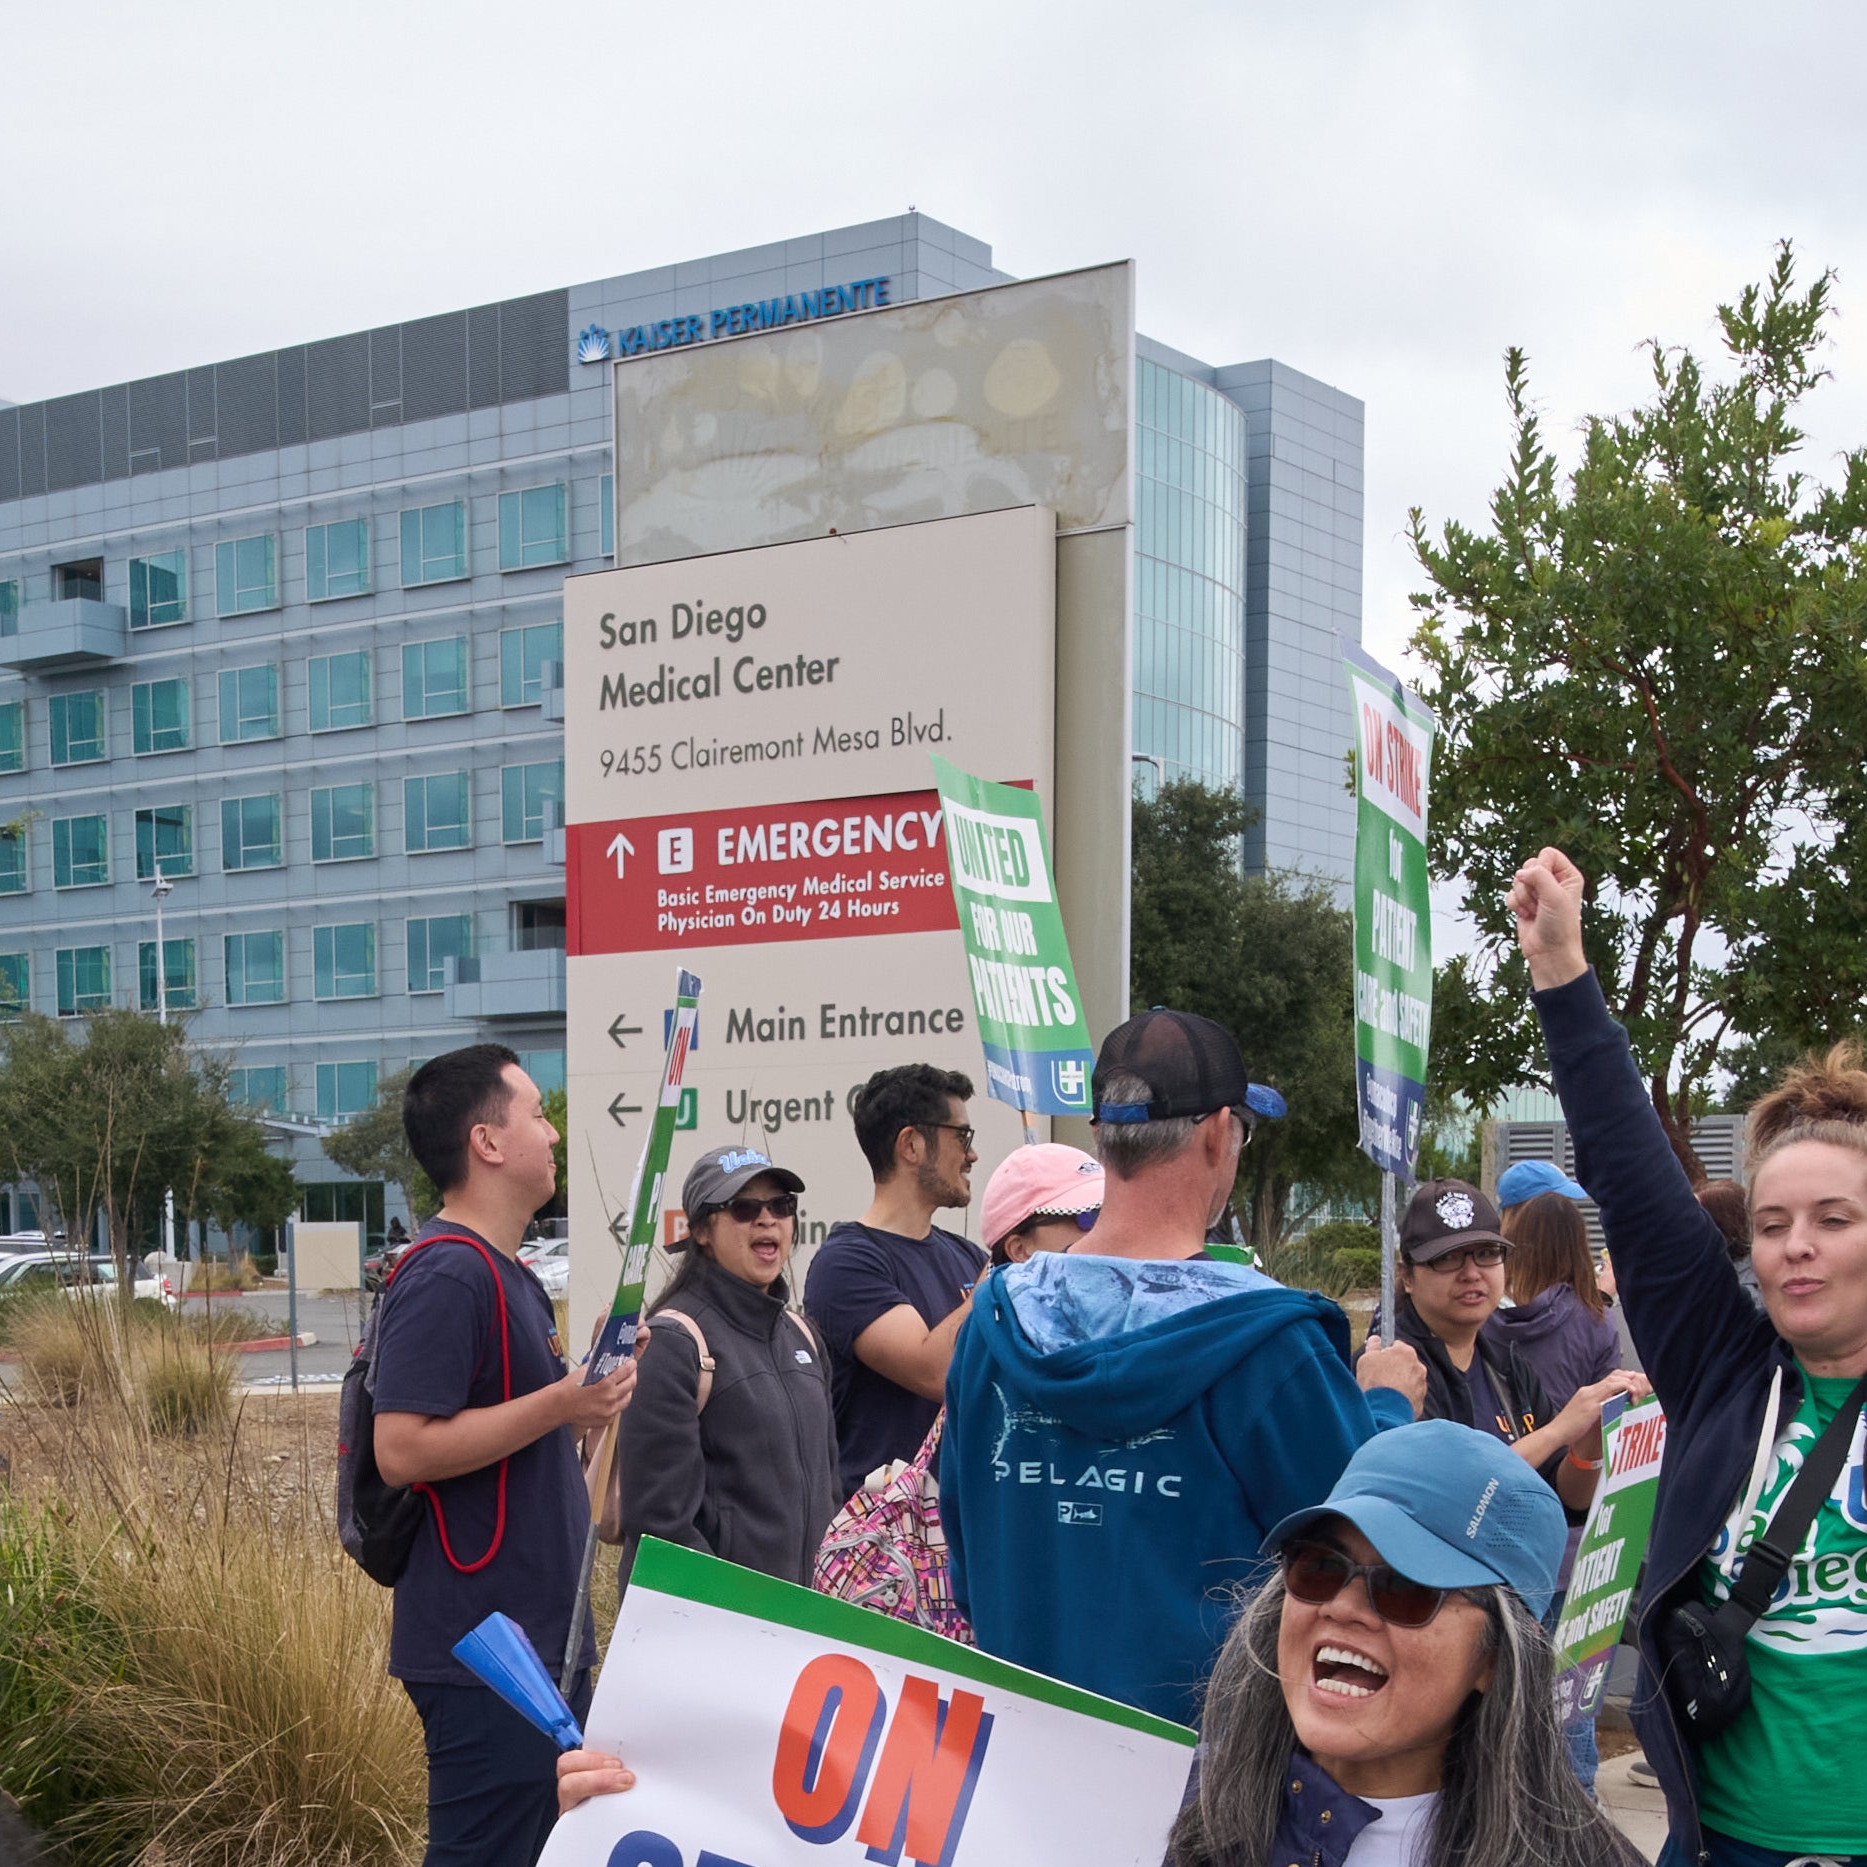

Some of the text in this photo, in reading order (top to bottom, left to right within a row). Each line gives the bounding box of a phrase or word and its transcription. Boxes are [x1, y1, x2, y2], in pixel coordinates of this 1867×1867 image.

[618, 276, 891, 355] KAISER PERMANENTE
[599, 600, 767, 650] San Diego
[599, 654, 840, 711] Medical Center
[600, 707, 952, 778] 9455 Clairemont Mesa Blvd.
[1364, 702, 1421, 819] ON STRIKE
[717, 810, 945, 866] EMERGENCY
[954, 813, 1031, 888] UNITED
[1389, 827, 1403, 883] for
[658, 868, 945, 909] Basic Emergency Medical Service
[658, 897, 900, 936] Physician On Duty 24 Hours
[970, 901, 1038, 956] FOR OUR
[1372, 888, 1418, 972] PATIENT
[969, 953, 1077, 1027] PATIENTS
[1357, 969, 1430, 1050] CARE and SAFETY
[726, 1003, 964, 1044] Main Entrance
[726, 1088, 835, 1133] Urgent
[995, 1460, 1182, 1497] PELAGIC
[1466, 1477, 1500, 1539] SALOMON
[1594, 1503, 1616, 1538] for
[1565, 1606, 1590, 1650] and
[1588, 1587, 1632, 1637] SAFETY
